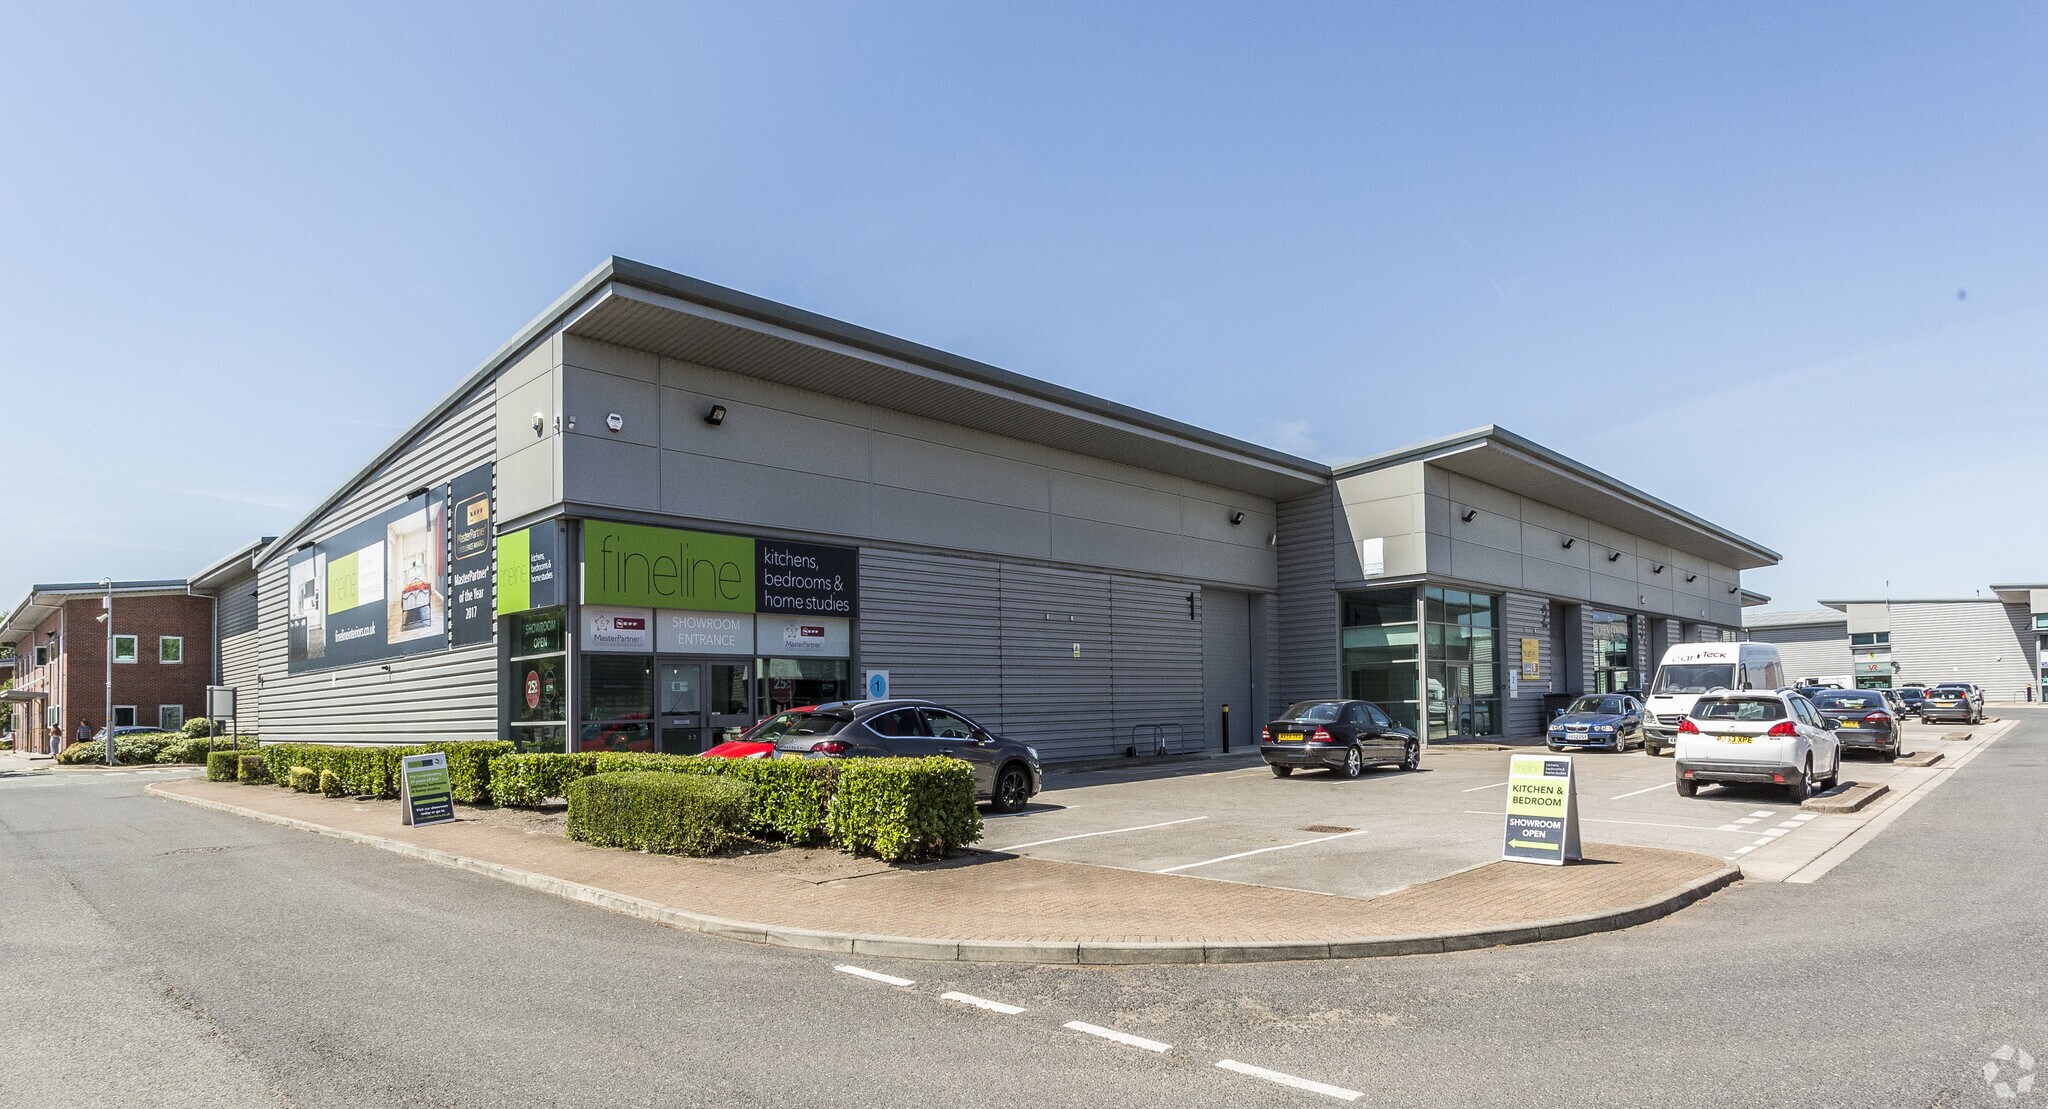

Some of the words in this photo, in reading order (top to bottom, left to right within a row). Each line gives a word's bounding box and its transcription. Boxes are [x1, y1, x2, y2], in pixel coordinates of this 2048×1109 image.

[765, 547, 819, 572] kitchens,
[601, 534, 742, 601] fineline
[765, 569, 831, 592] bedrooms
[833, 576, 845, 592] &
[459, 590, 466, 604] of
[473, 587, 484, 601] Year
[765, 592, 804, 610] home
[806, 593, 851, 613] studies
[465, 605, 477, 620] 2017
[525, 619, 557, 635] SHOWROOM
[673, 616, 741, 631] SHOWROOM
[533, 637, 548, 649] OPEN
[678, 633, 736, 647] ENTRANCE
[875, 680, 880, 692] 1
[1512, 784, 1554, 795] KITCHEN
[1556, 786, 1564, 795] &
[1512, 796, 1562, 807] BEDROOM
[1509, 818, 1561, 829] SHOWROOM
[1522, 829, 1546, 838] OPEN
